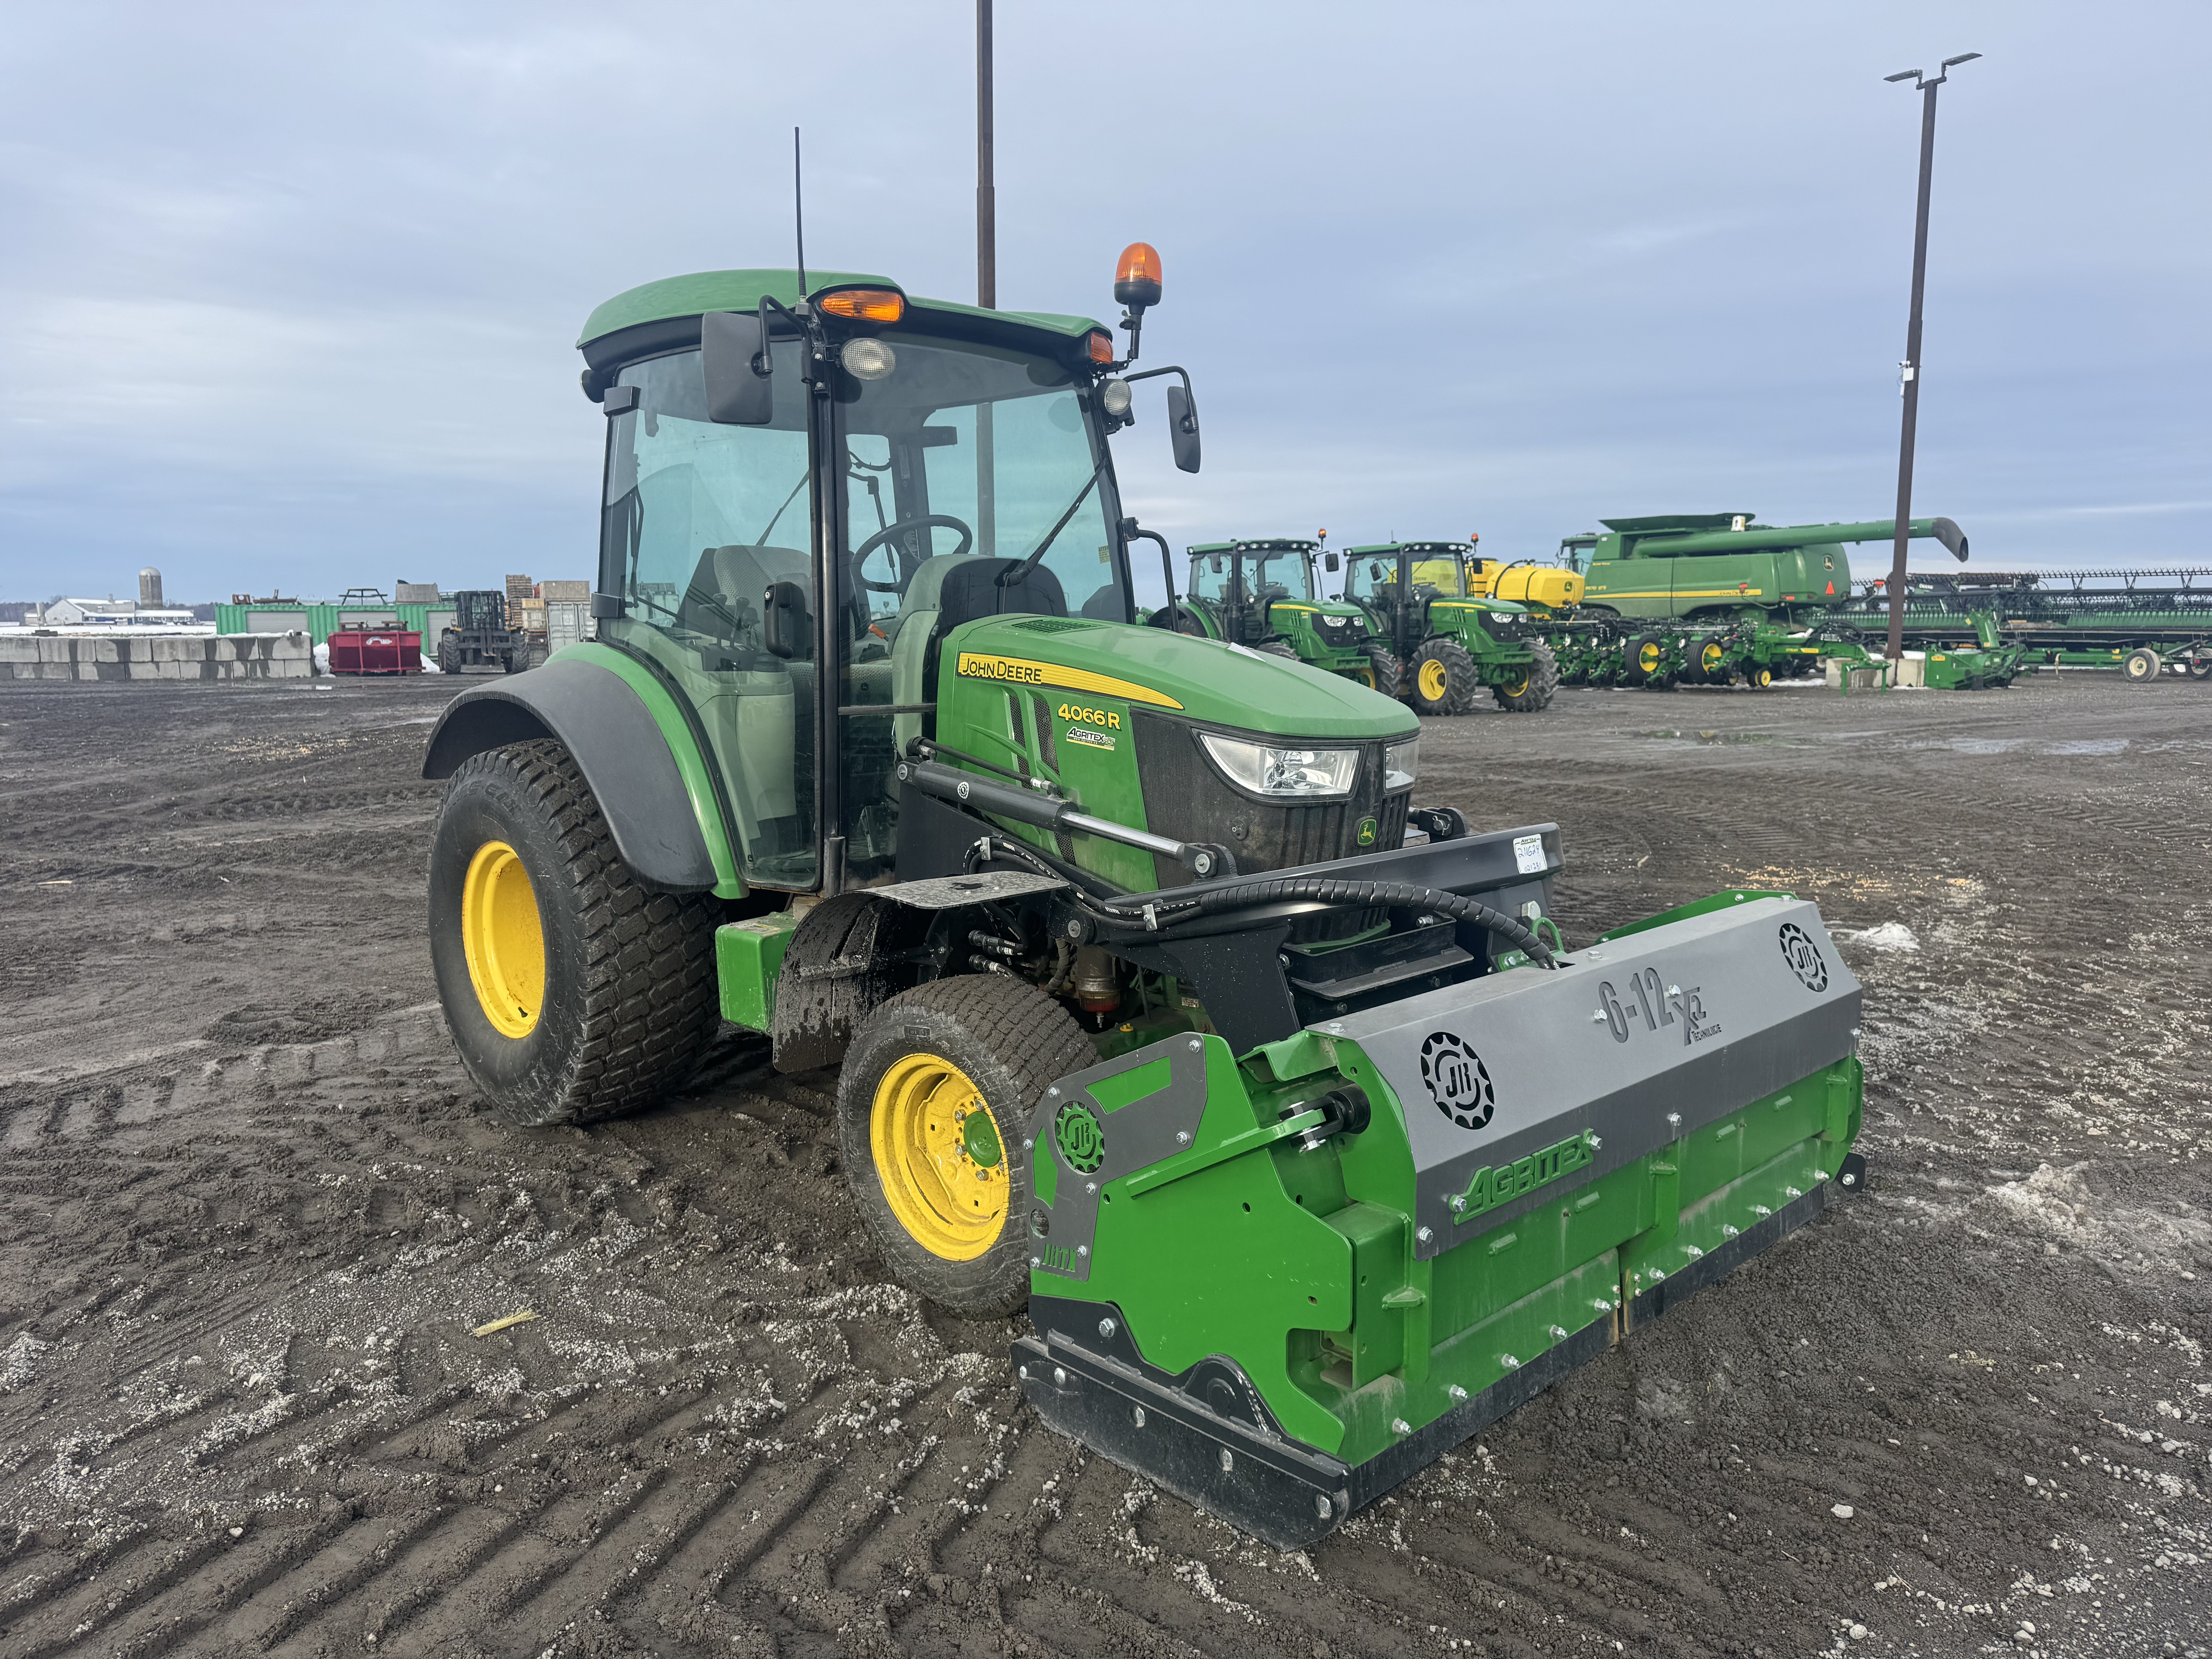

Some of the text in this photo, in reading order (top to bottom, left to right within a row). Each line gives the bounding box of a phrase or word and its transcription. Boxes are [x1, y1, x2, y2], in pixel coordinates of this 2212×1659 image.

[963, 658, 1042, 682] JOHN DEERE
[1068, 728, 1104, 742] AGRITEX
[1598, 967, 1674, 1043] 6-12
[1453, 1128, 1594, 1225] AGRITEX
